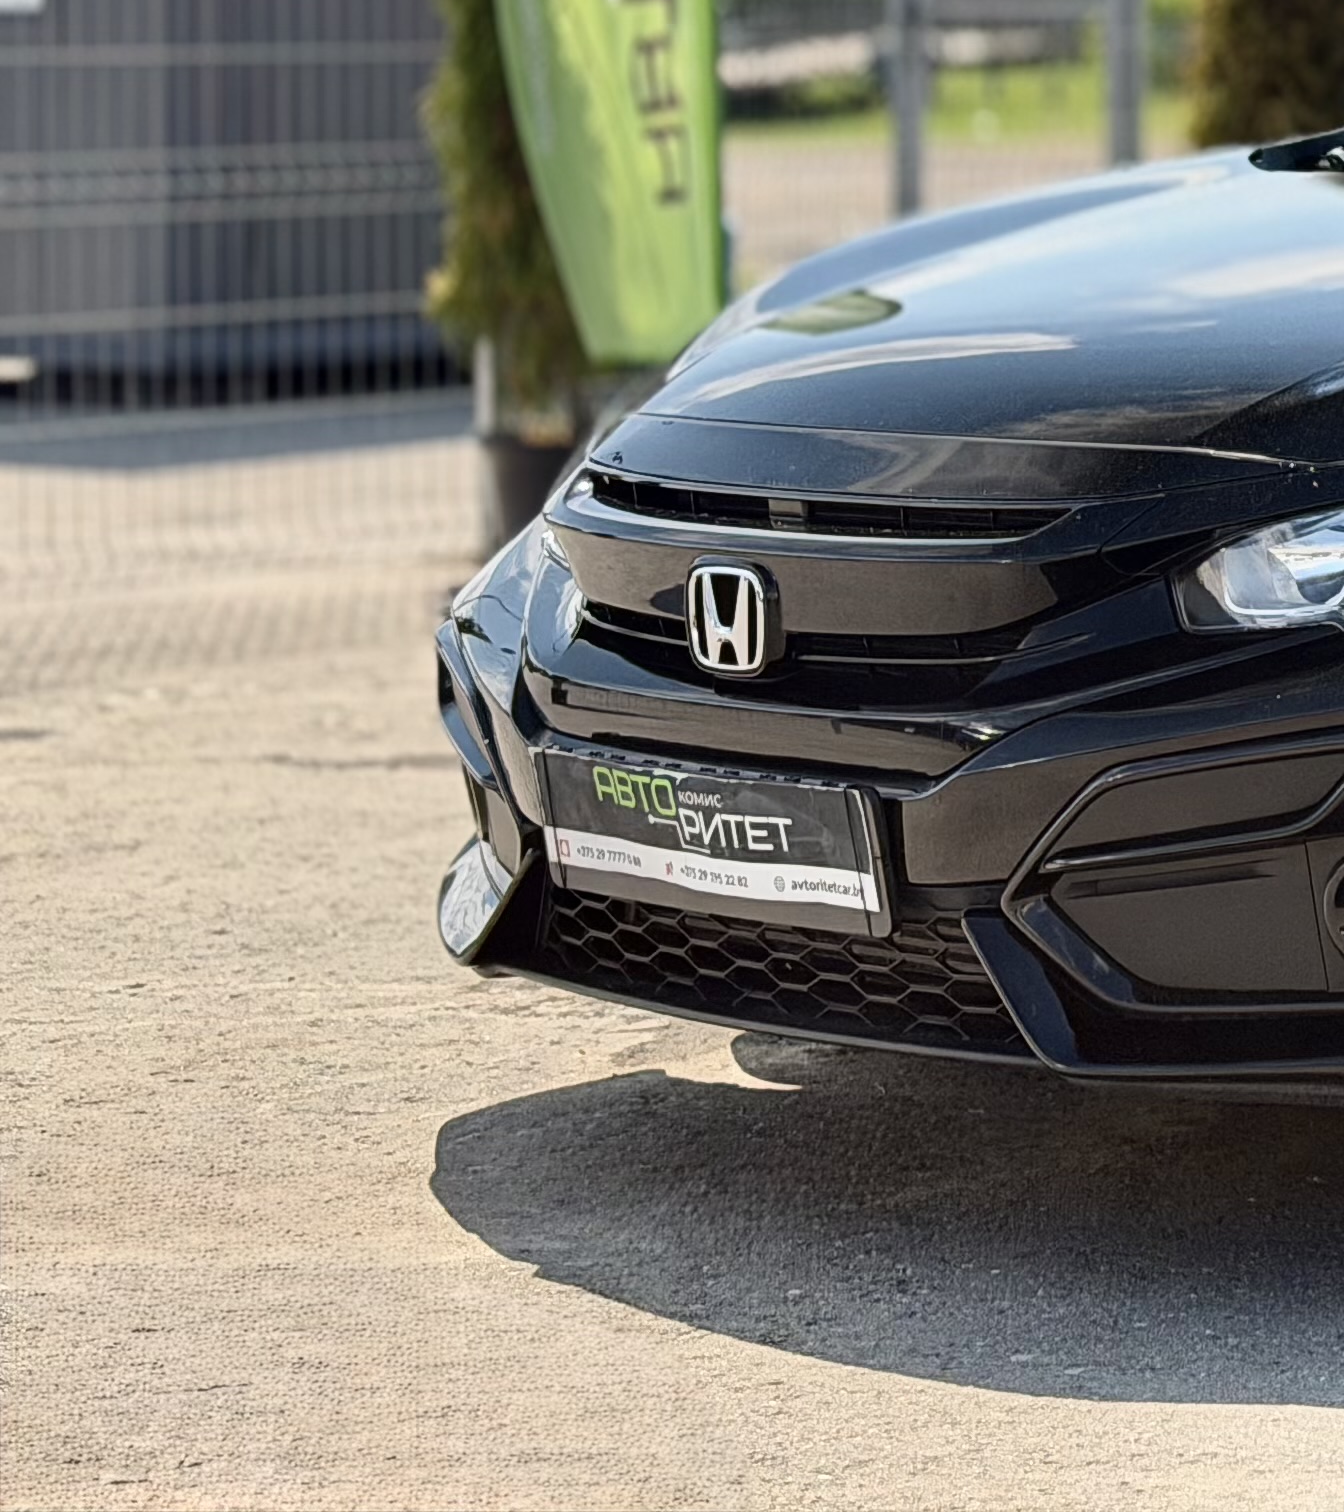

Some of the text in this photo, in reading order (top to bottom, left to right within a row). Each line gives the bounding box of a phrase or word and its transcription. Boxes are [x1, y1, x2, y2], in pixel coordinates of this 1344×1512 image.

[592, 765, 677, 817] АВТО
[678, 790, 722, 808] КОМИС
[678, 807, 792, 852] РИТЕТ
